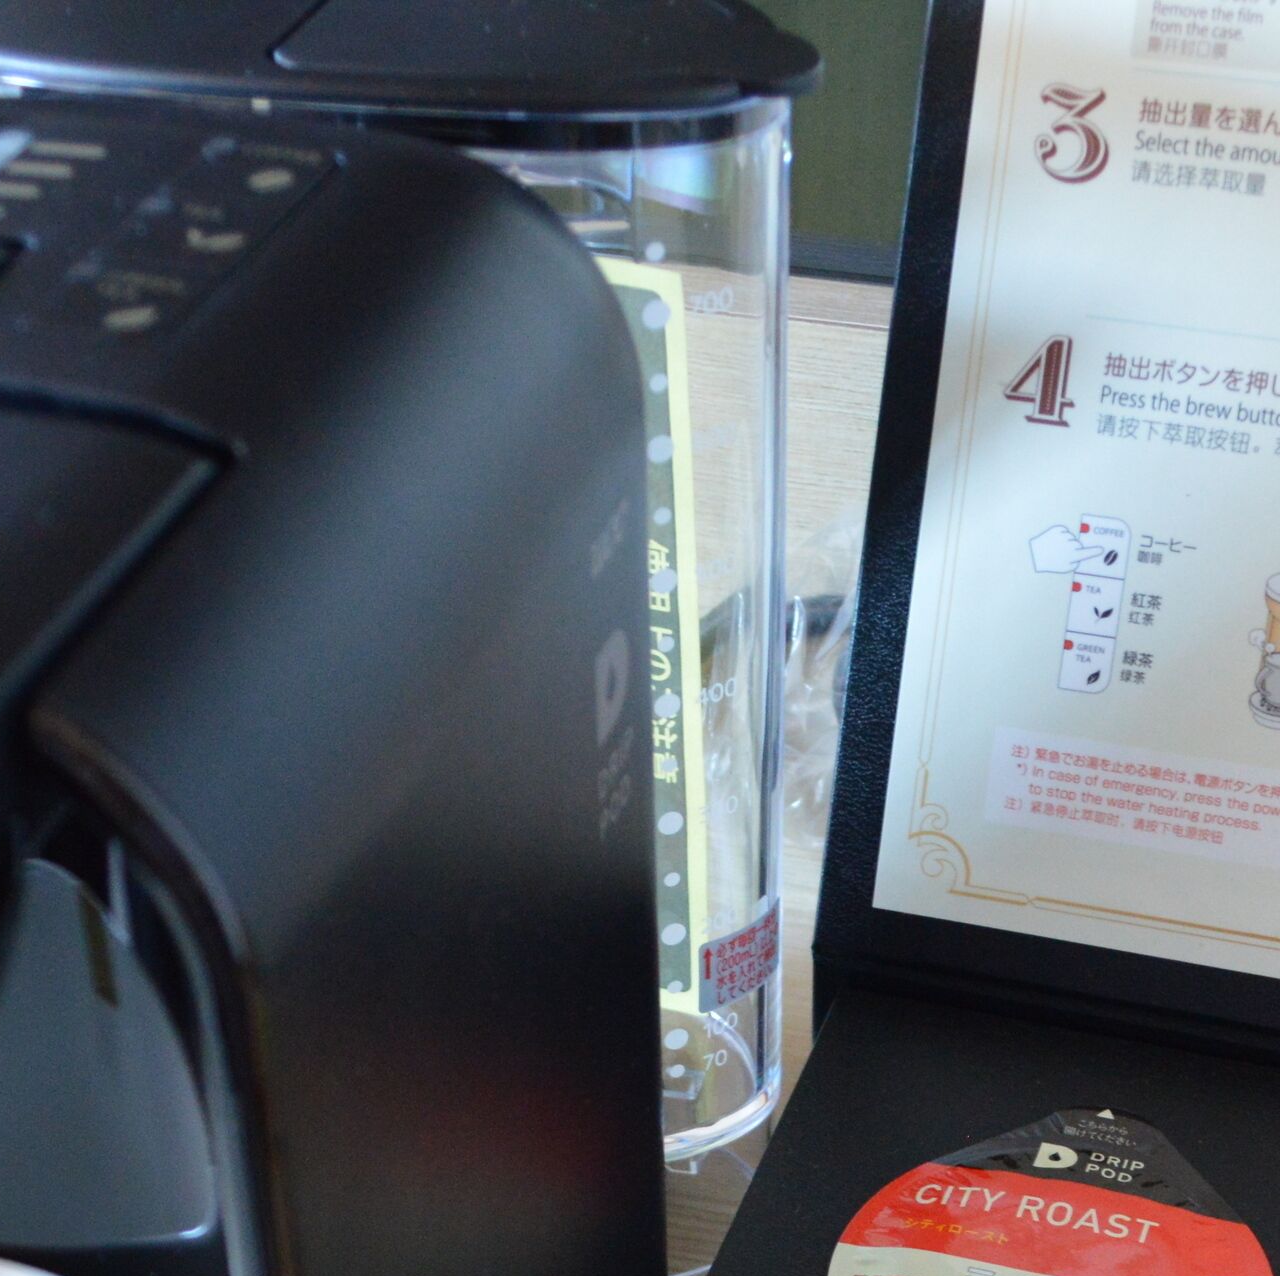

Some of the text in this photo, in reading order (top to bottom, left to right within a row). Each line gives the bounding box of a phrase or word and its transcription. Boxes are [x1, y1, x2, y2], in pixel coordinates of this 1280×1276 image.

[1033, 82, 1110, 183] 3
[1134, 129, 1188, 156] Select
[1194, 136, 1226, 160] the
[1003, 334, 1075, 427] 4
[1099, 384, 1146, 410] Press
[1150, 391, 1181, 414] the
[1184, 396, 1233, 420] brew
[1140, 534, 1198, 553] コーヒー
[1085, 1163, 1133, 1183] POD
[1090, 1152, 1145, 1171] DRIP
[913, 1183, 1161, 1245] CITY ROAST
